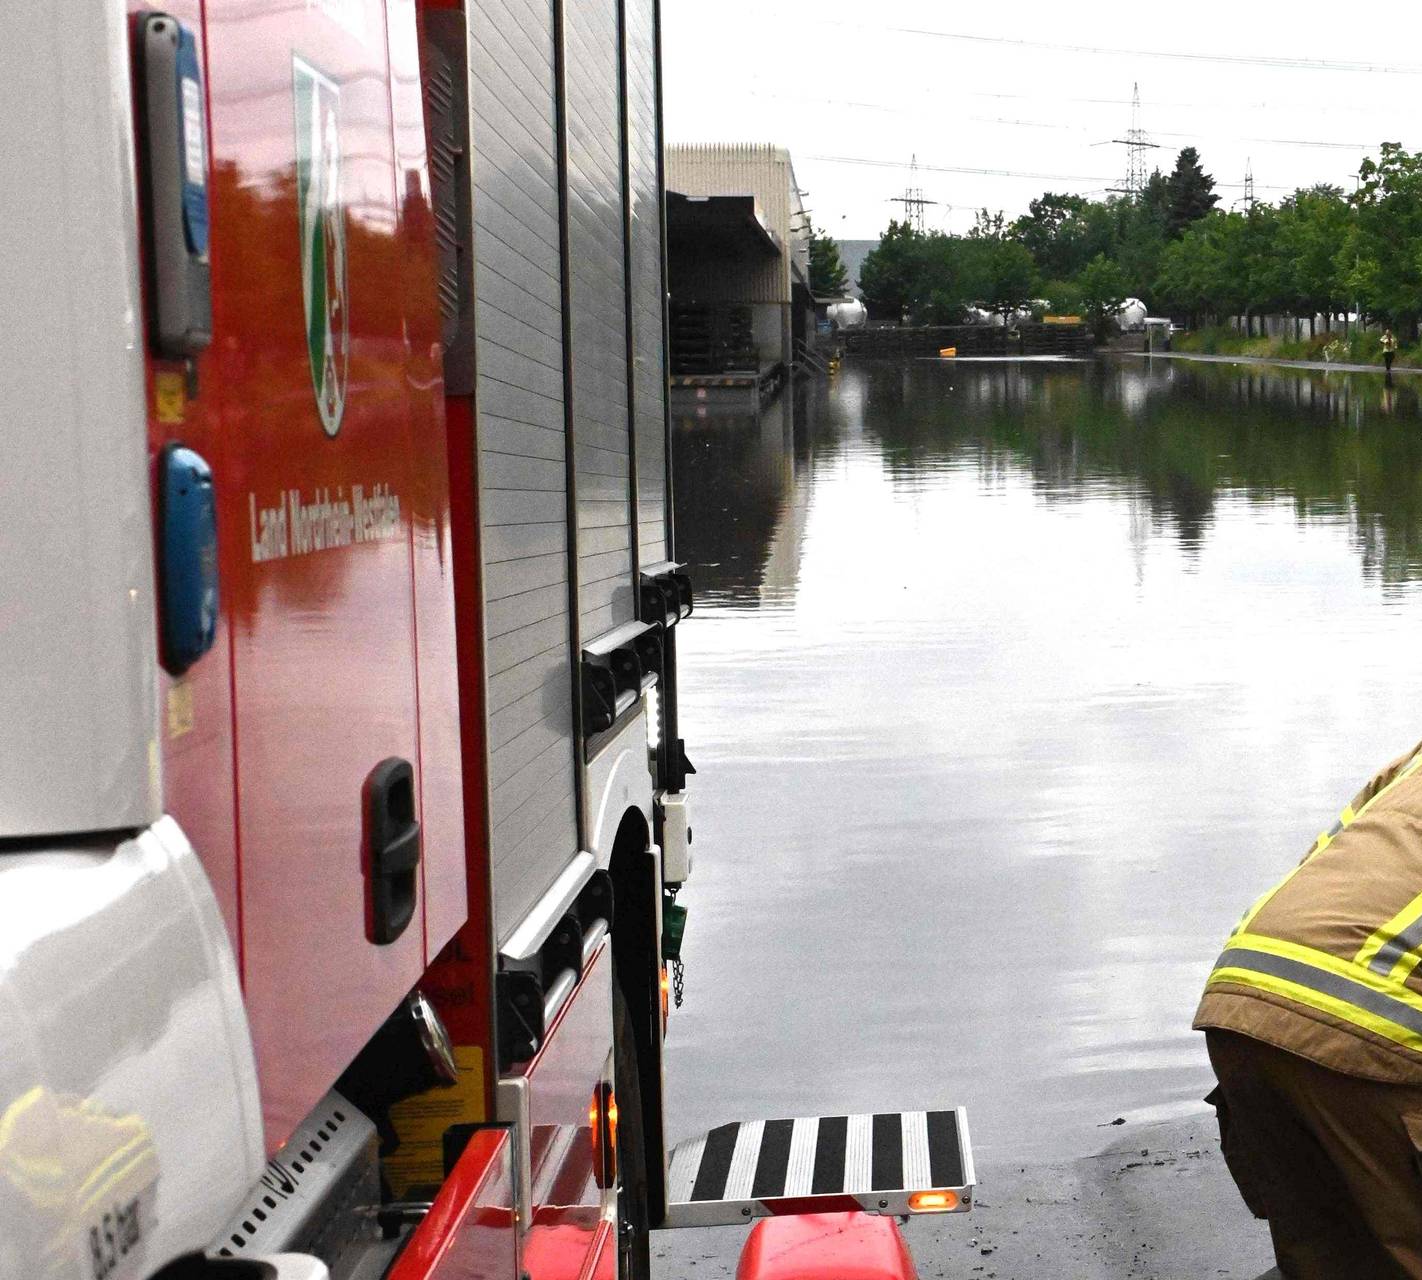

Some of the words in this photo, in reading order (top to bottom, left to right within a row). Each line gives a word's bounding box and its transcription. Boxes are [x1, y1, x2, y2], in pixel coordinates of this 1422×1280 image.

[249, 491, 287, 562] Land
[289, 482, 400, 556] Nordrhein-Westfalen
[113, 1199, 140, 1256] bar
